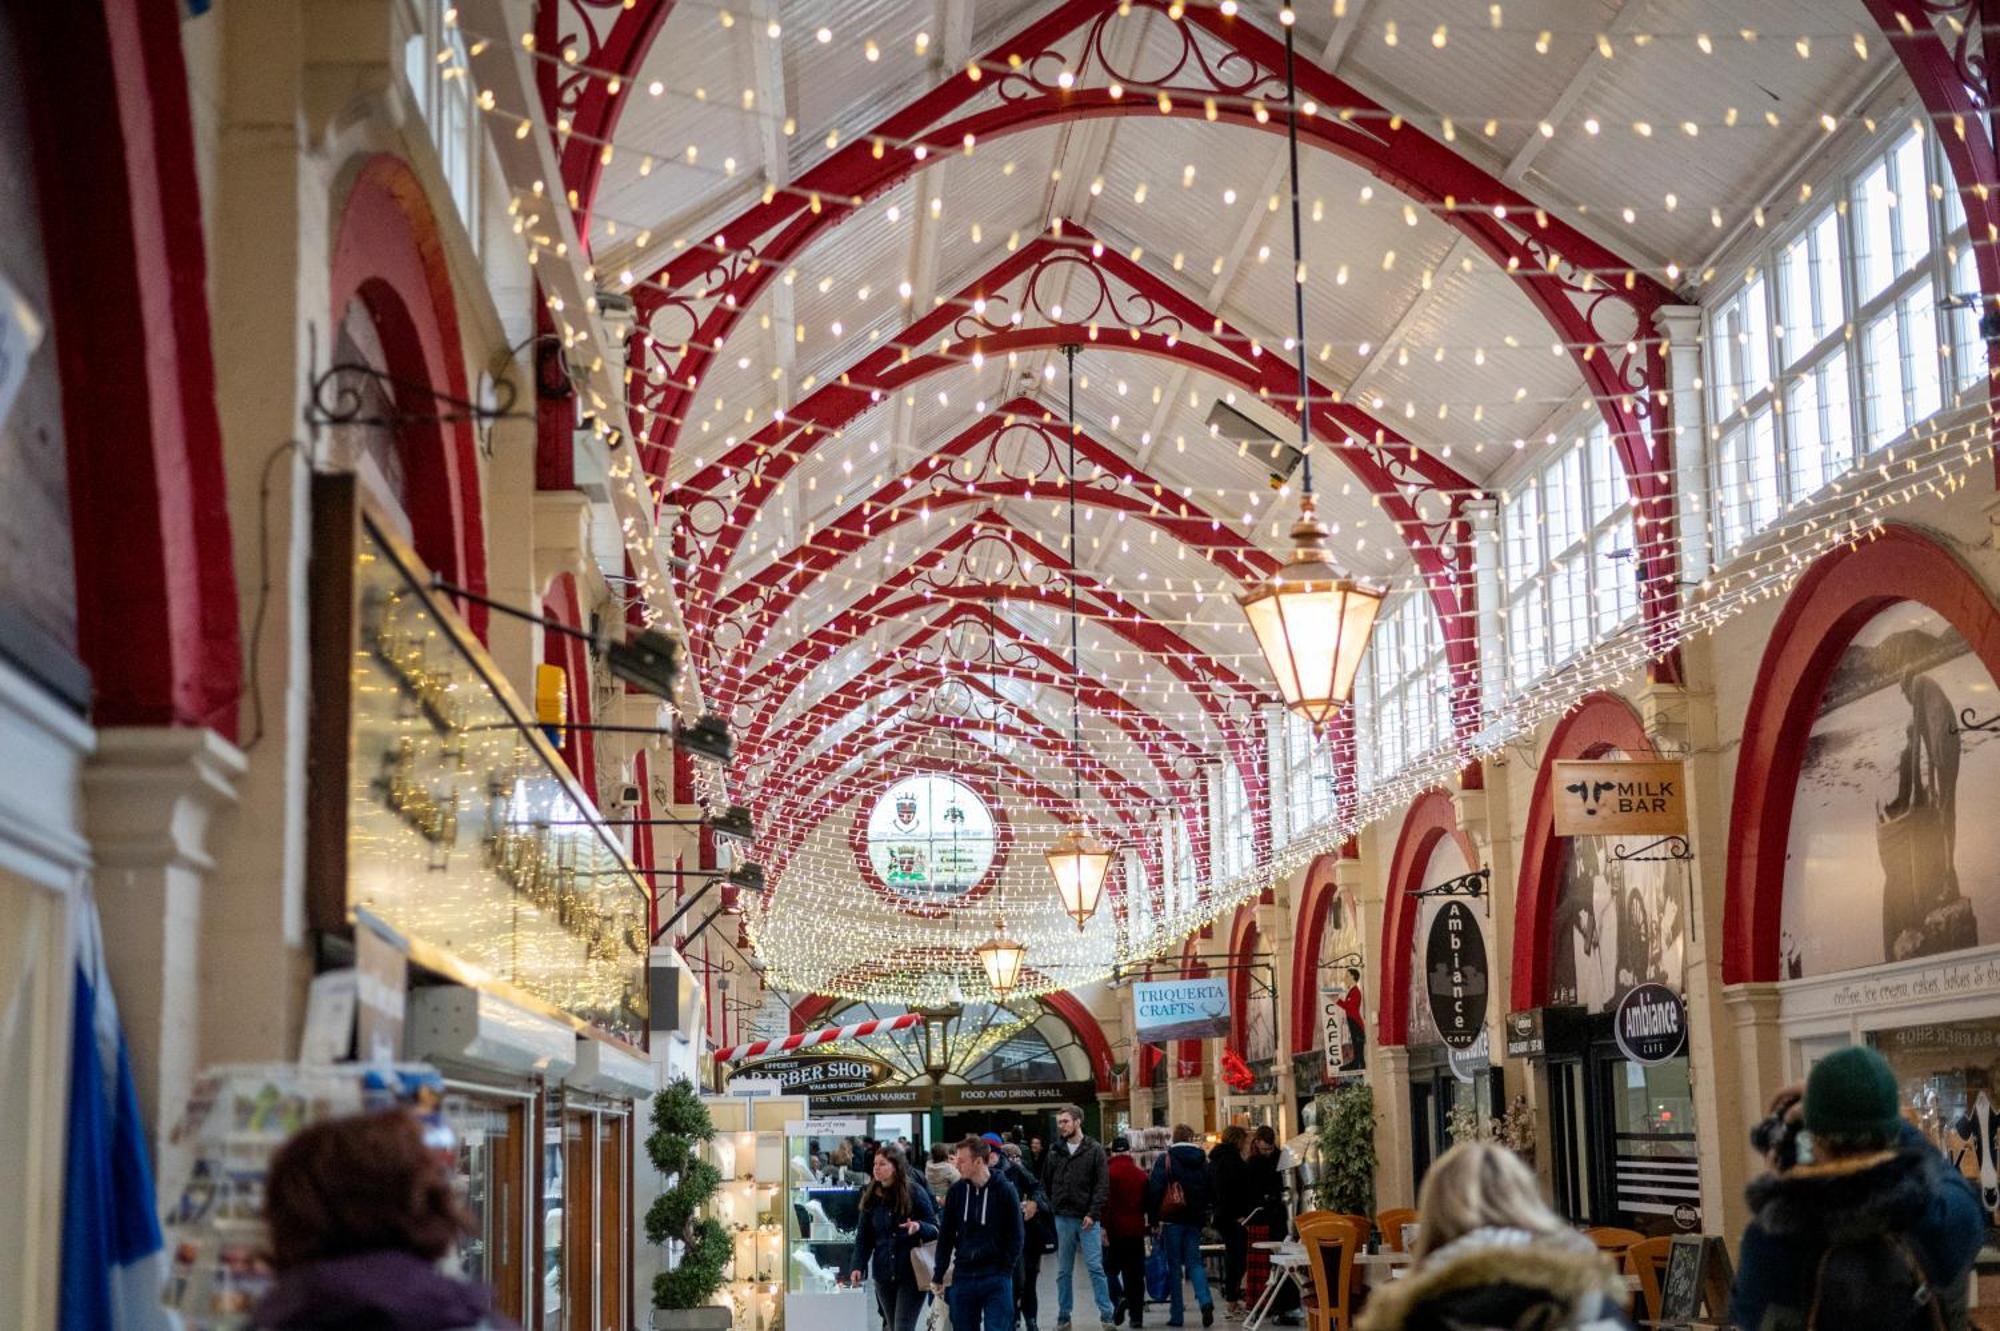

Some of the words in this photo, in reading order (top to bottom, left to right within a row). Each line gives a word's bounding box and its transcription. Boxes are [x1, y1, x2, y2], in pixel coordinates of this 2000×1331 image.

[1618, 782, 1674, 797] MILK
[1619, 798, 1666, 813] BAR
[1448, 904, 1464, 1029] Ambiance
[1974, 965, 1984, 985] &
[1138, 987, 1224, 1002] TRIQUERTA
[1140, 1002, 1195, 1017] CRAFTS
[1626, 993, 1678, 1038] Ambiance
[1325, 1003, 1339, 1056] CAFE
[1447, 1035, 1472, 1043] CAFE
[1643, 1043, 1663, 1054] CAFE
[827, 1063, 872, 1078] SHOP
[831, 1093, 879, 1102] VICTORIAN
[880, 1092, 917, 1100] MARKET
[961, 1091, 985, 1099] FOOD
[987, 1090, 1006, 1098] AND
[1009, 1089, 1036, 1098] DRINK
[1038, 1089, 1062, 1097] HALL
